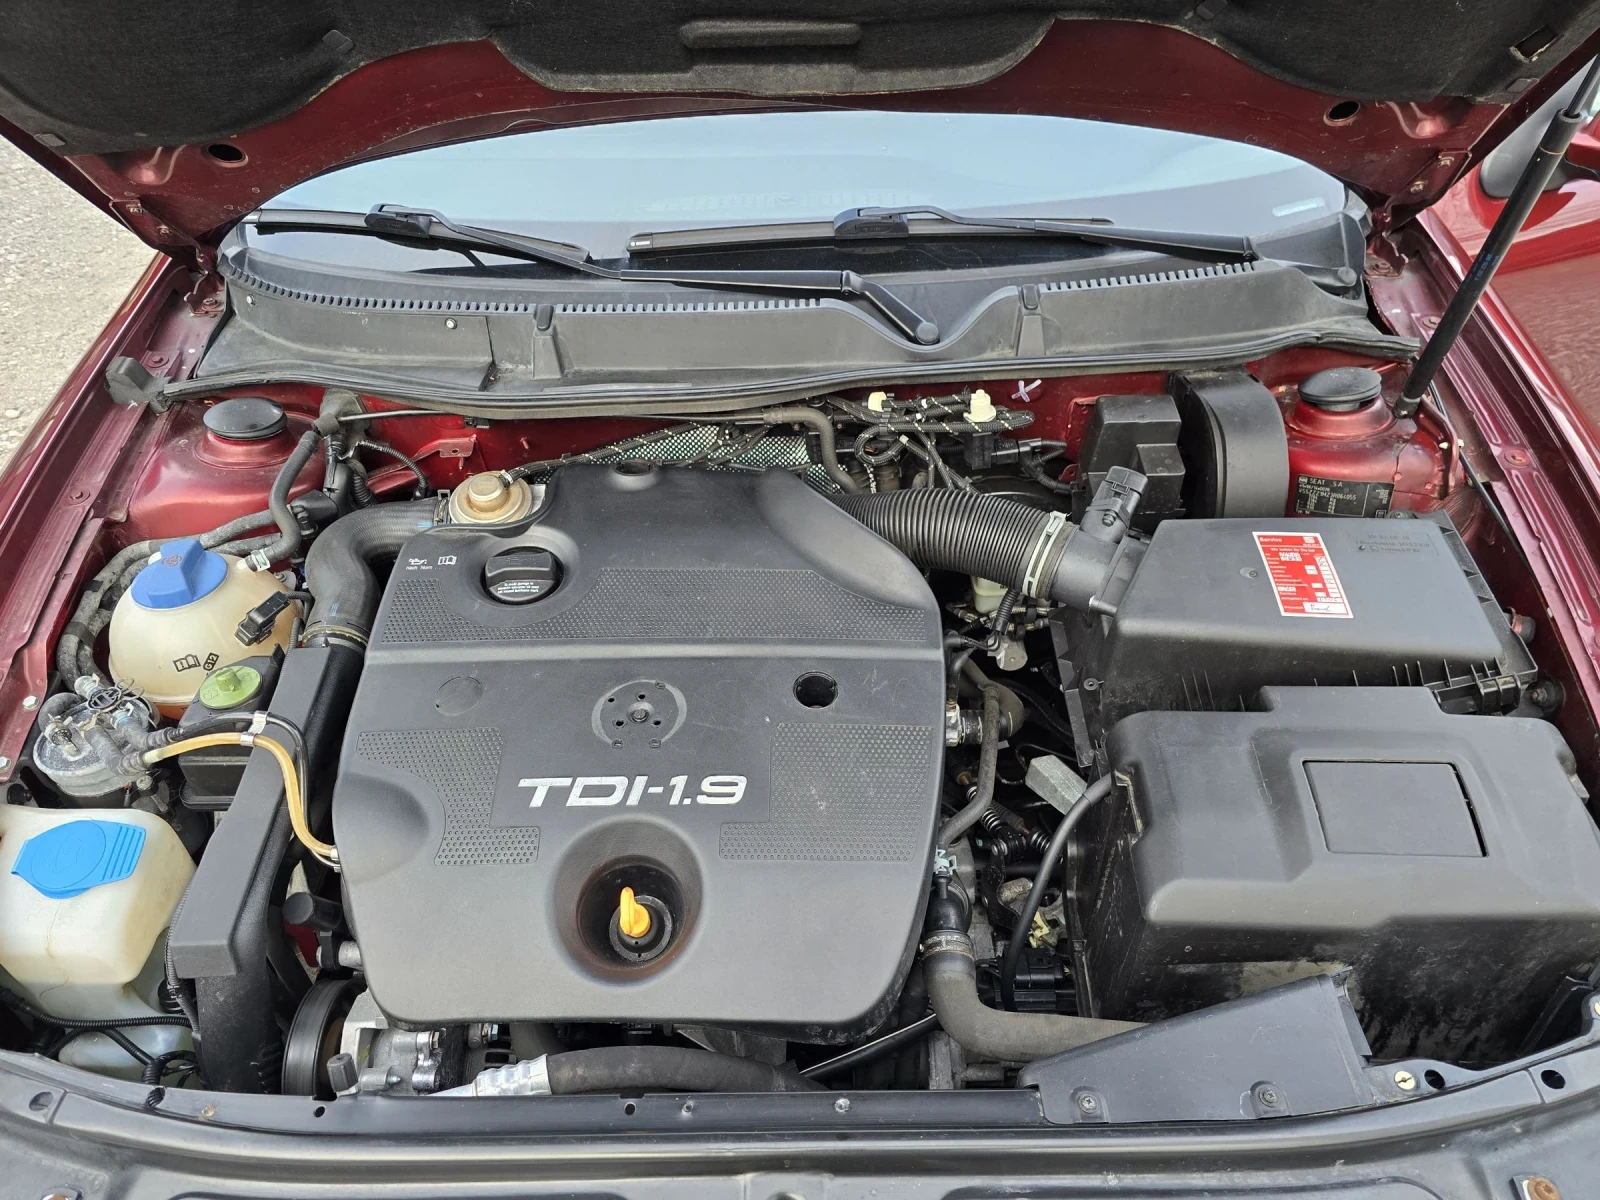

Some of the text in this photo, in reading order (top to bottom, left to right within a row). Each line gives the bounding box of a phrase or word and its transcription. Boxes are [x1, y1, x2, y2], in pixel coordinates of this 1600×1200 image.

[1309, 477, 1325, 485] SEAT
[204, 654, 218, 669] G12
[518, 775, 748, 807] TDI-1.9
